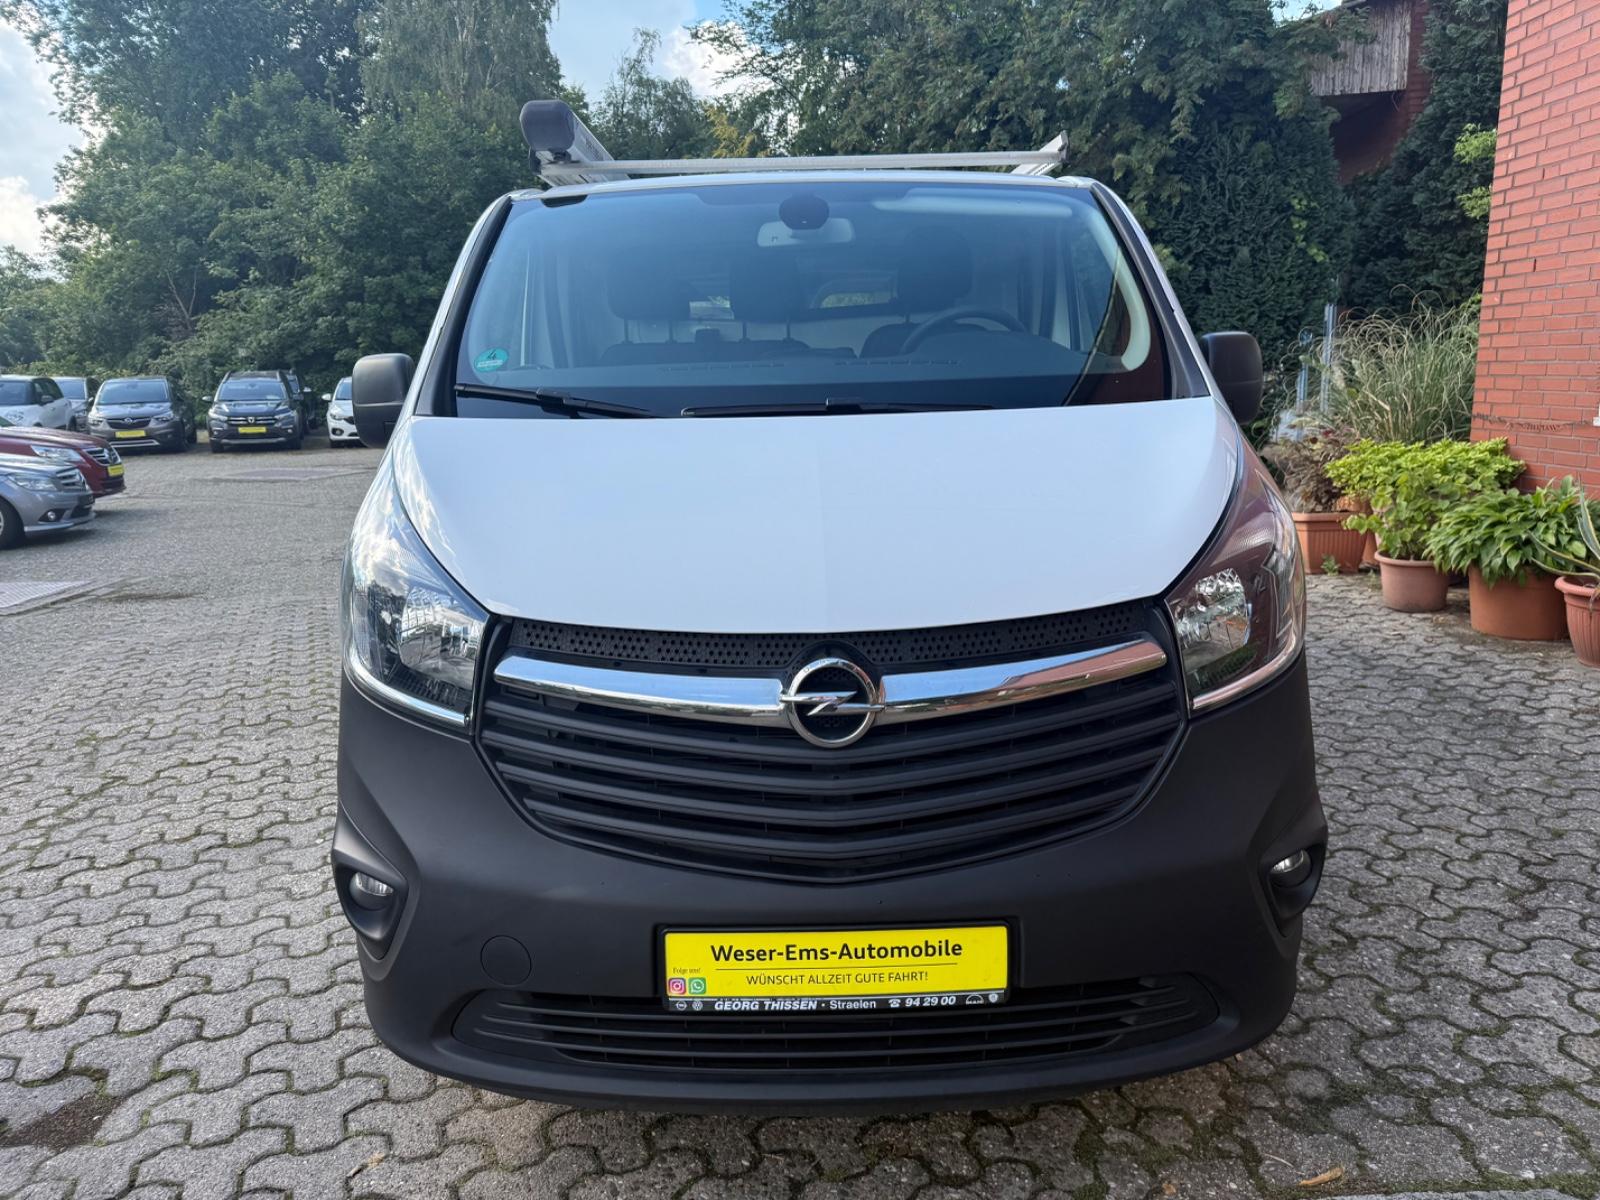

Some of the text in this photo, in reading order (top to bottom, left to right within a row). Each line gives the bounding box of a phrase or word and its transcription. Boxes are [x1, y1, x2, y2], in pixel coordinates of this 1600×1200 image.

[710, 939, 963, 962] Weser-Ems-Automobile
[746, 971, 929, 985] WÜNSCHT ALLZEIT GUTE FAHRT!
[714, 995, 957, 1011] GEORG THISSEN Straelen 94 29 00
